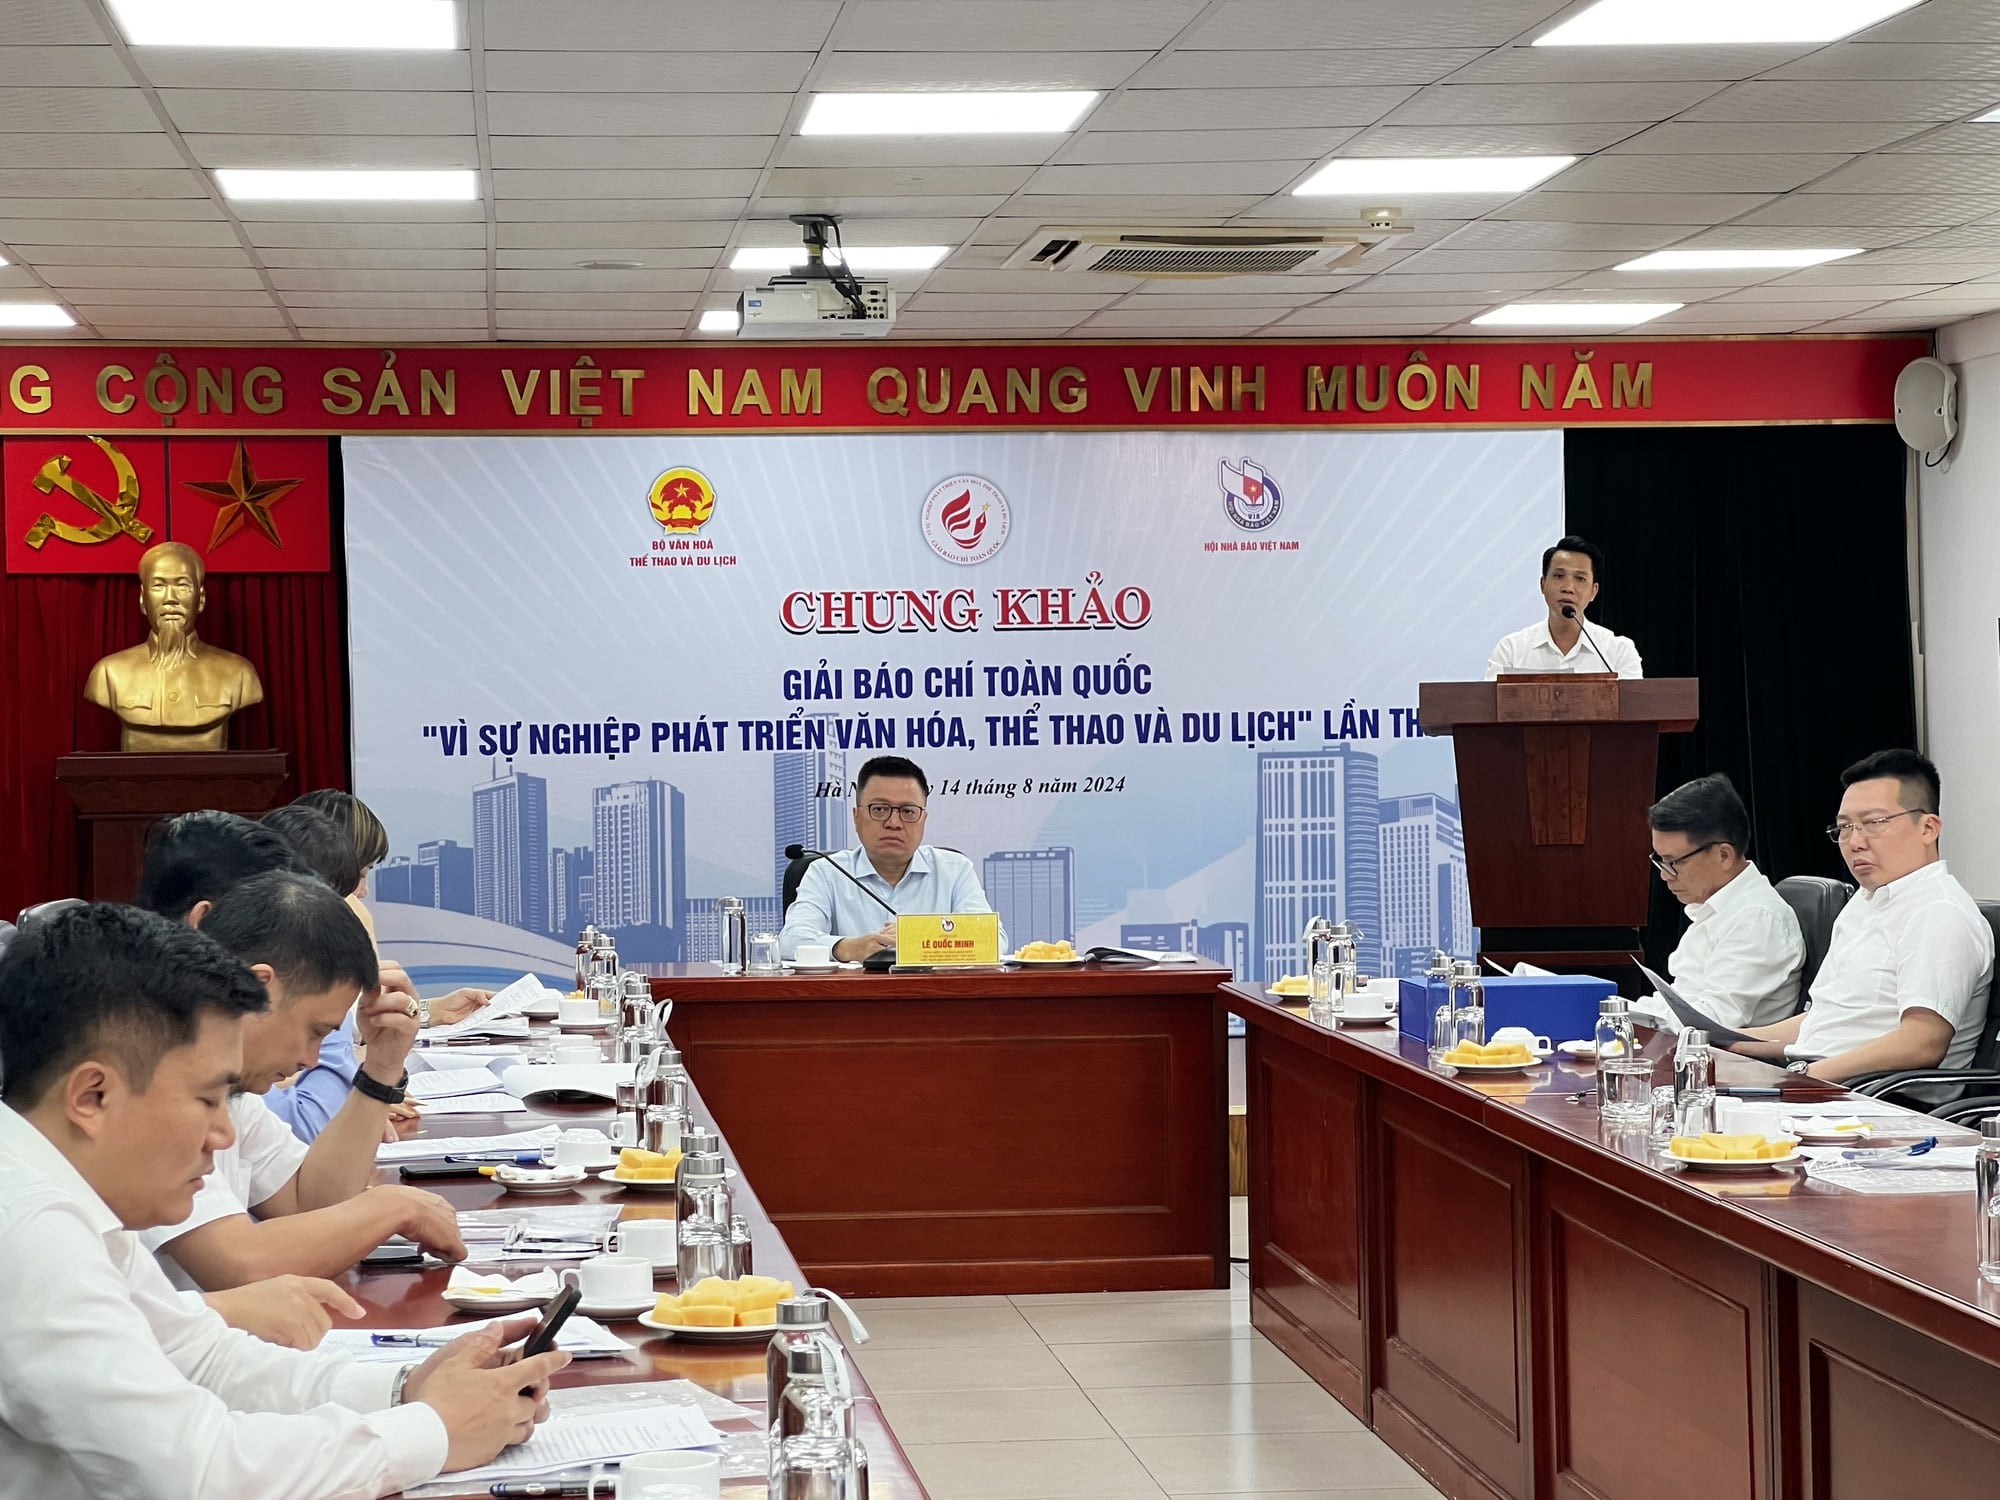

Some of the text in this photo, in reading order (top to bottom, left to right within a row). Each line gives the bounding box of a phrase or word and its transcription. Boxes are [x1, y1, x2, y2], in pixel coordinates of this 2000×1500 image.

[96, 353, 285, 428] CỘNG
[322, 350, 457, 417] SẢN
[501, 355, 646, 428] VIỆT
[688, 368, 824, 416] NAM
[866, 364, 1089, 417] QUANG
[1123, 362, 1266, 413] VINH
[1306, 351, 1480, 413] MUÔN
[1520, 349, 1654, 411] NĂM
[652, 538, 714, 552] BỘ VĂN HOÁ
[1204, 540, 1299, 553] HỘI NHÀ BÁO VIỆT NAM
[629, 553, 737, 568] THỂ THAO VÀ DU LỊCH
[779, 570, 1153, 635] CHUNG KHẢO
[782, 653, 1152, 701] GIẢI BÁO CHÍ TOÀN QUỐC
[422, 698, 1425, 763] "VÌ SỰ NGHIỆP PHÁT TRIỂN VĂN HÓA, THỂ THAO VÀ DU LỊCH" LẦN TH
[815, 781, 842, 799] Hà
[940, 778, 960, 796] 14
[966, 779, 1017, 799] tháng
[1022, 778, 1033, 794] 8
[1039, 776, 1078, 793] năm
[1083, 775, 1126, 793] 2024
[954, 939, 974, 949] MINH
